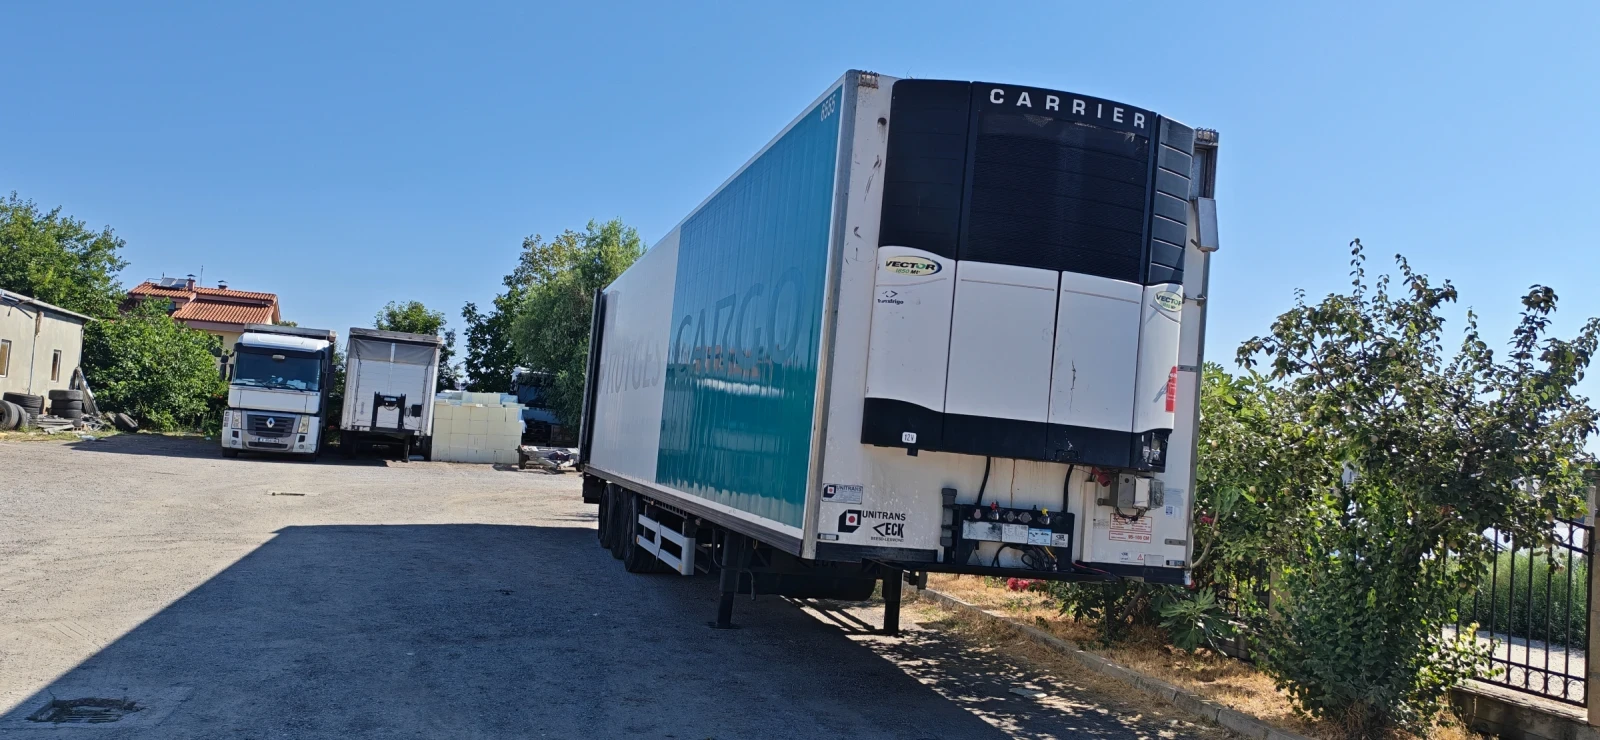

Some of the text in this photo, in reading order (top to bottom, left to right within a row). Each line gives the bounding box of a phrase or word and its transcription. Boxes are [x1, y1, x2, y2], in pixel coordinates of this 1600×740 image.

[990, 89, 1145, 129] CARRIER
[886, 260, 936, 271] VECTOR
[675, 267, 804, 381] CARGO
[862, 510, 906, 521] UNITRANS
